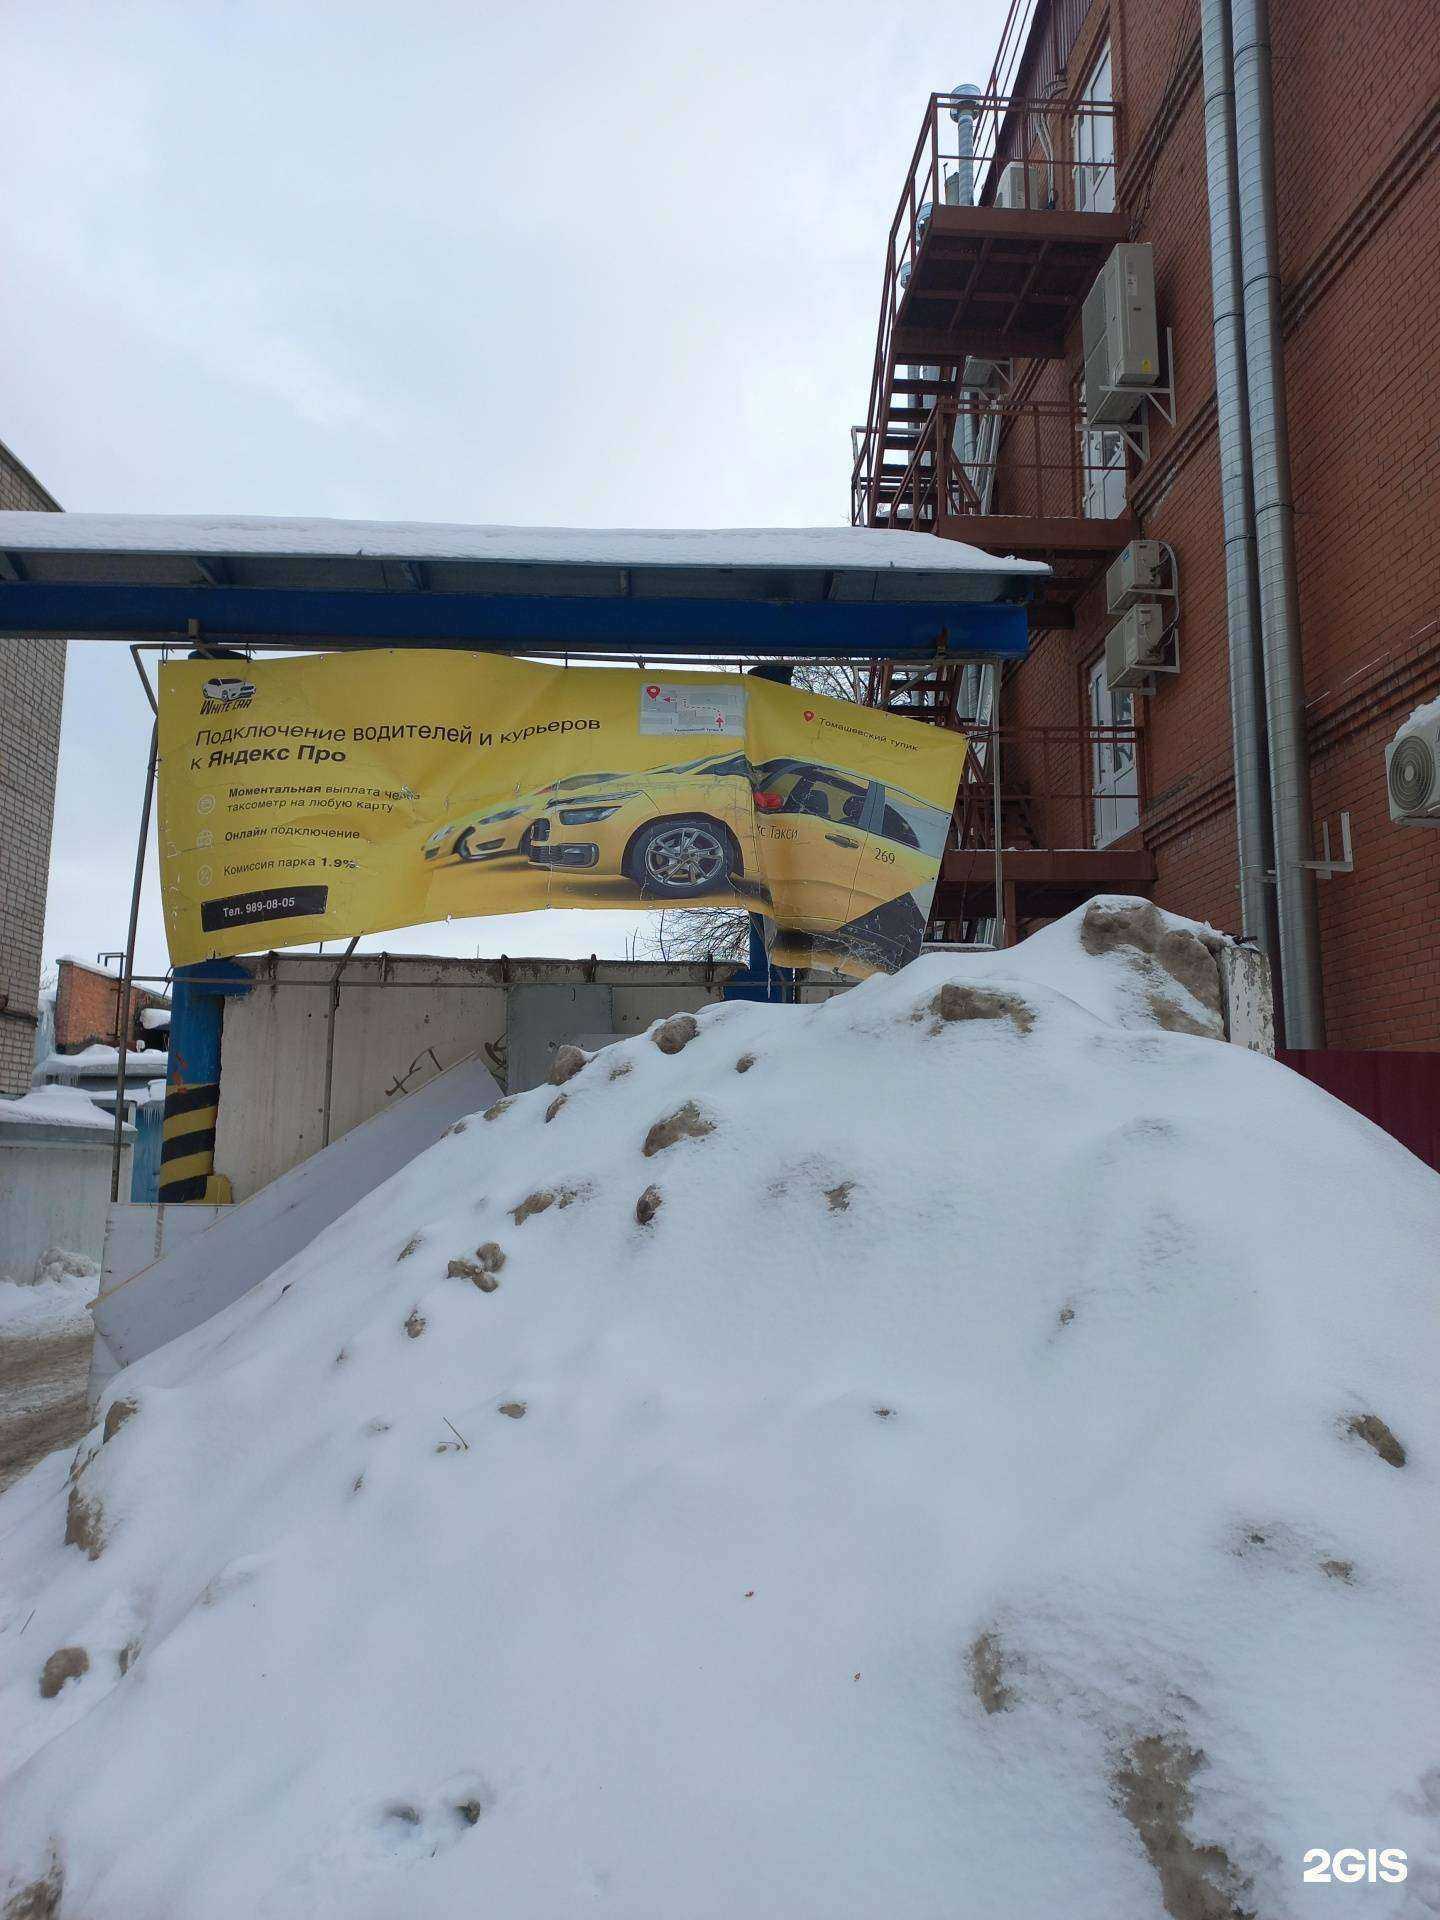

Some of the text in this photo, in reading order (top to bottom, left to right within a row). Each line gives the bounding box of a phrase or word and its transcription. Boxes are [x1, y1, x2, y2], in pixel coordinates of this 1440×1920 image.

[195, 719, 600, 746] Подключение водителей и курьеров
[819, 717, 920, 751] Томашевский тупик
[208, 748, 290, 768] Яндекс
[297, 745, 346, 764] Про
[228, 785, 321, 798] Моментальная
[325, 785, 380, 797] выплата
[227, 797, 394, 813] таксометр на любую карту
[225, 826, 360, 841] Онлайн подключение
[770, 825, 799, 840] Такси
[874, 847, 895, 865] 269
[224, 861, 275, 876] Комиссия
[278, 858, 316, 869] парка
[223, 897, 296, 918] Тел. 989-08-05
